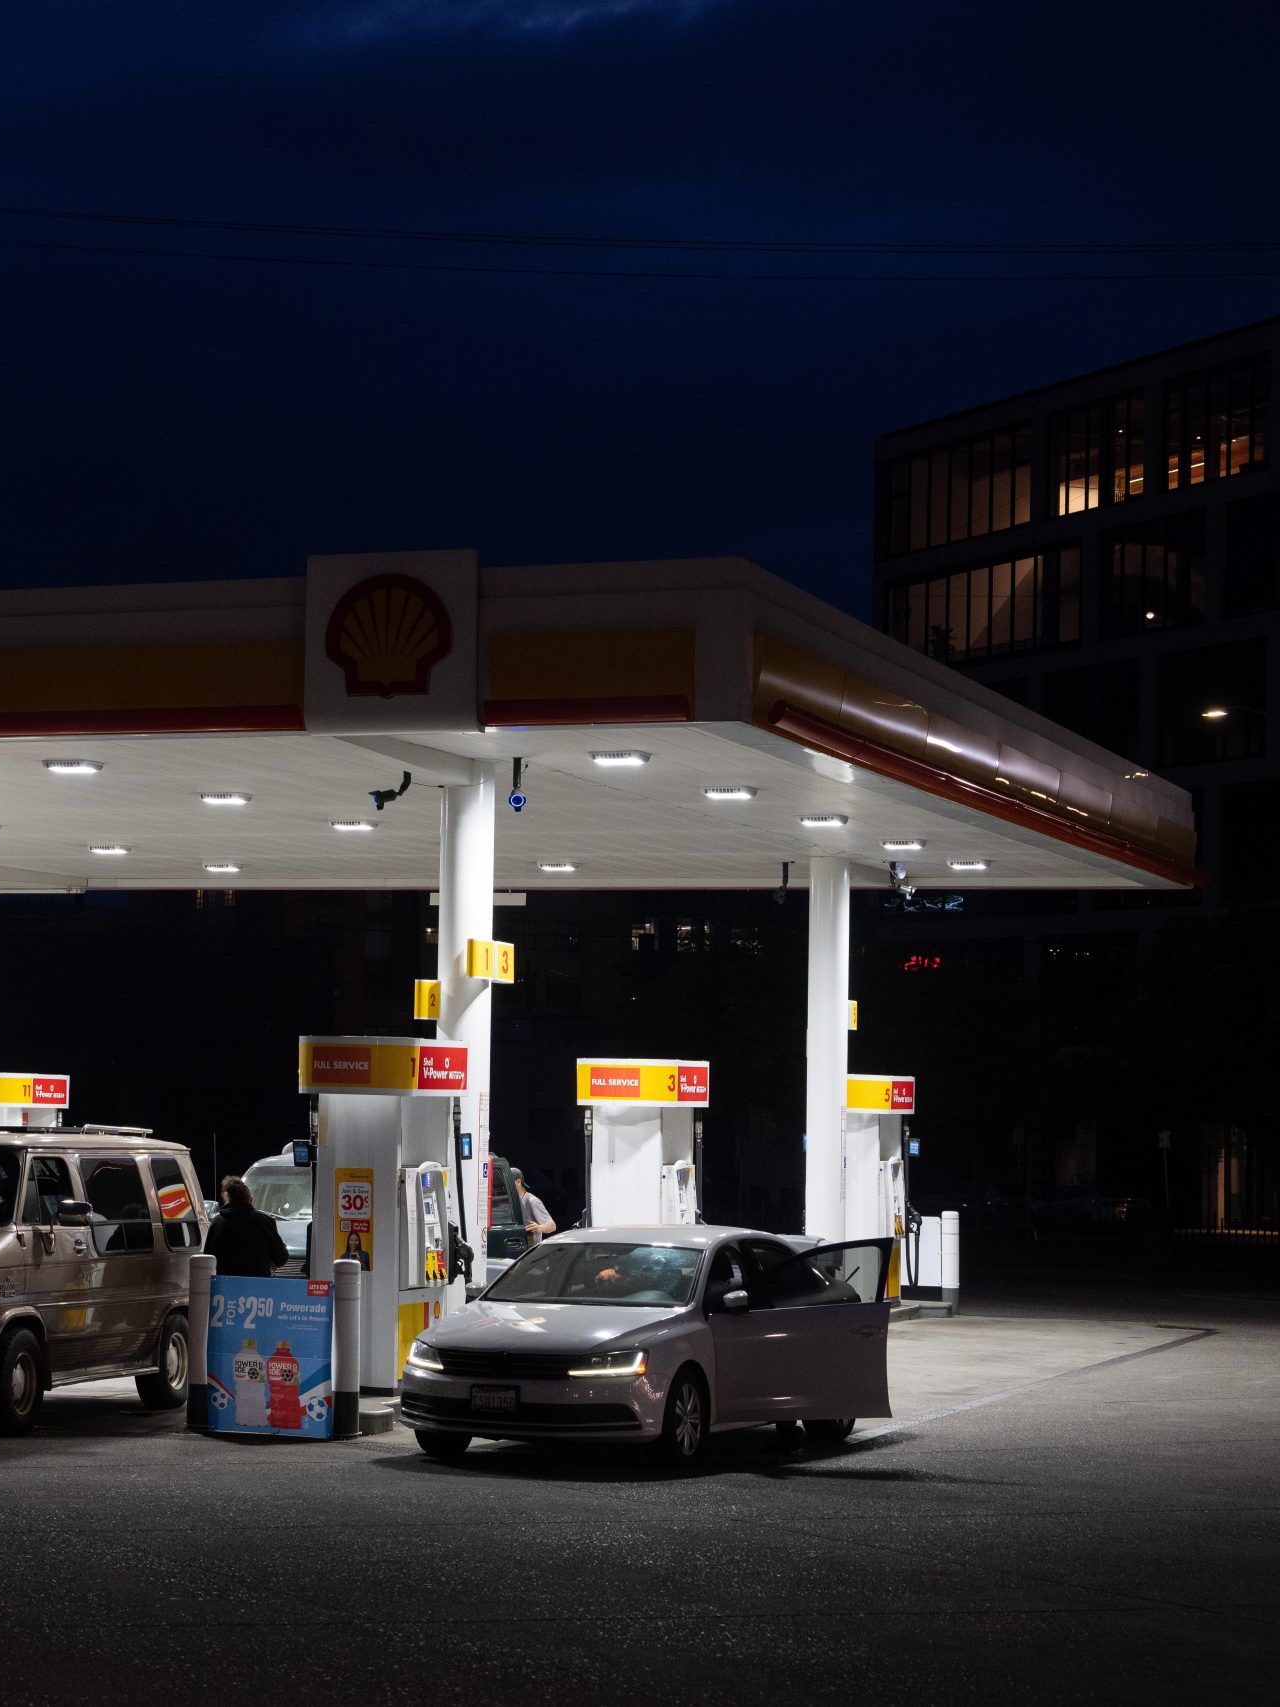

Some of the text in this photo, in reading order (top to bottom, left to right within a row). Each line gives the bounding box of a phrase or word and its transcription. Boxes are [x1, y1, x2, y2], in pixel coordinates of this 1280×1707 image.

[485, 948, 489, 971] 1
[502, 950, 508, 974] 3
[430, 994, 436, 1007] 2
[314, 1061, 369, 1070] FULL SERVICE
[410, 1057, 416, 1078] 1
[423, 1057, 434, 1066] Shell
[423, 1067, 448, 1079] V-Power
[608, 1078, 639, 1087] SERVICE
[668, 1074, 676, 1092] 3
[23, 1084, 30, 1096] 11
[884, 1088, 890, 1102] 5
[210, 1294, 225, 1328] 2
[226, 1300, 237, 1326] FOR
[280, 1302, 326, 1314] Powerade
